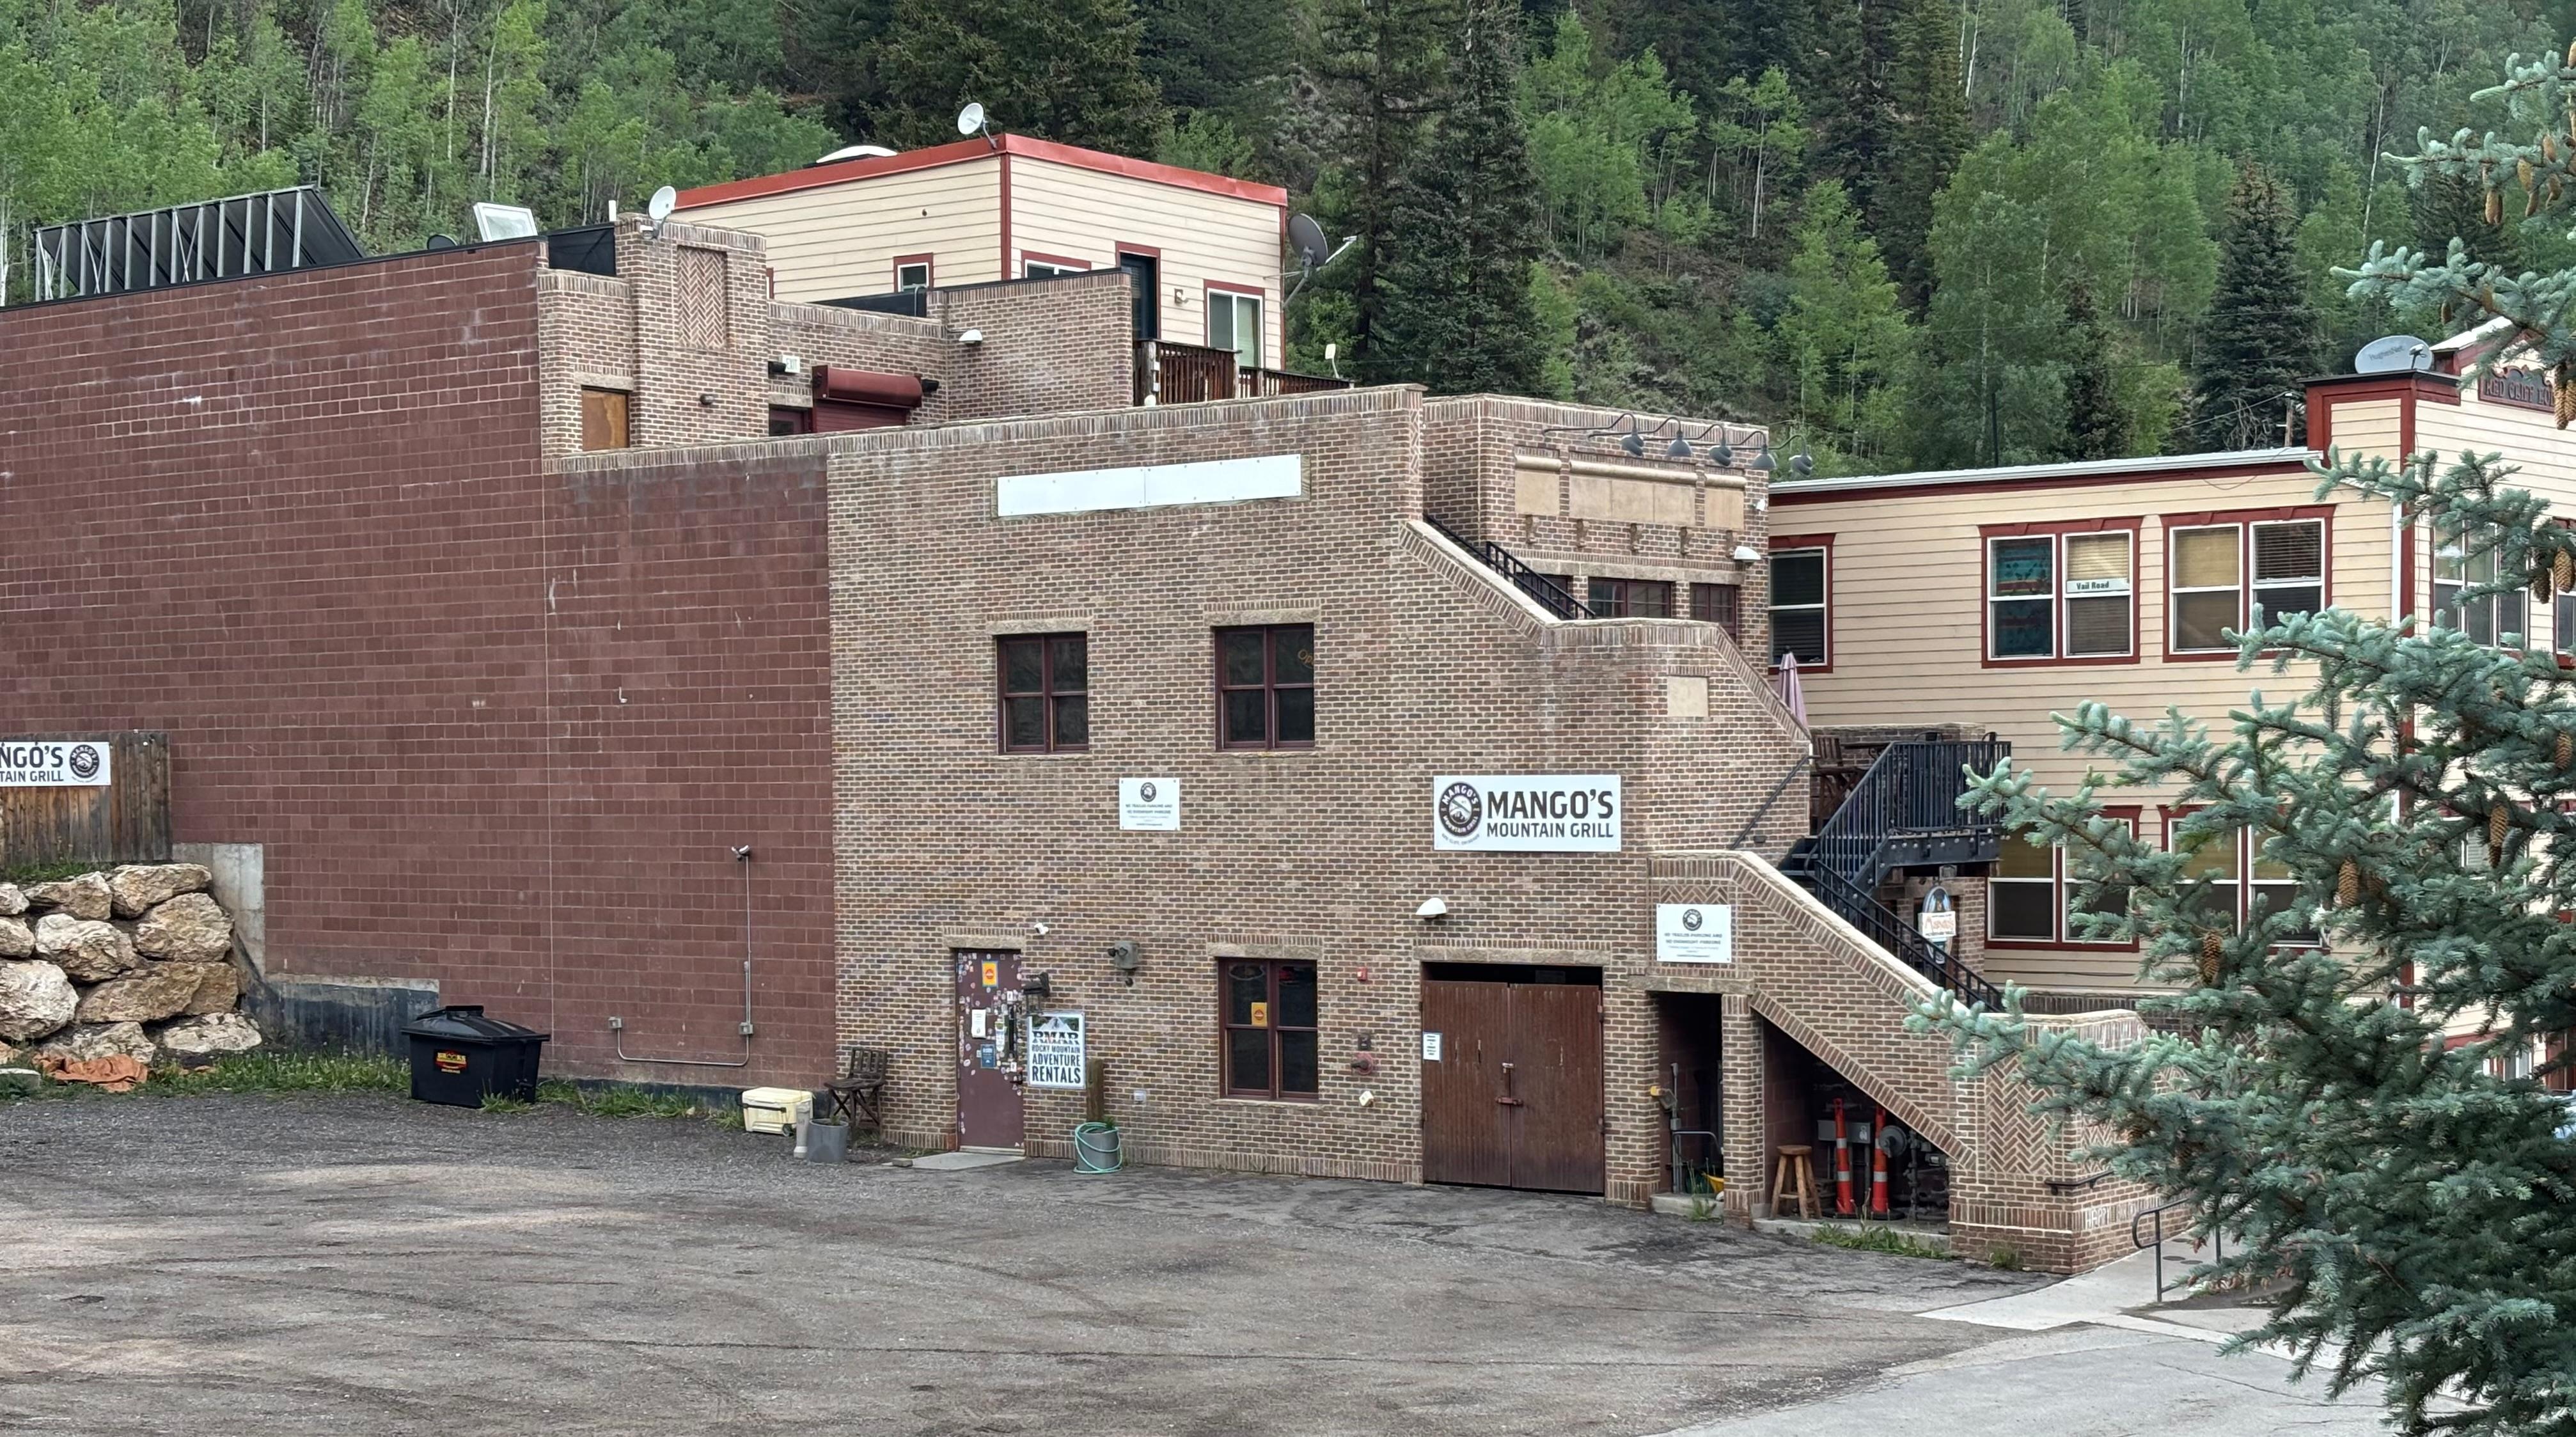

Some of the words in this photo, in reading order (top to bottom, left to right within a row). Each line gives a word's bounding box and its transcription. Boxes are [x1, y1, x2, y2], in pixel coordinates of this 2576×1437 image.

[2485, 379, 2505, 398] RED
[2508, 382, 2534, 403] CLIFF
[2092, 581, 2109, 589] Road
[30, 770, 64, 782] GRILL
[1441, 785, 1479, 805] MANGO'S
[1487, 789, 1614, 819] MANGO'S
[1487, 822, 1565, 838] MOUNTAIN
[1570, 822, 1614, 838] GRILL
[1032, 1030, 1080, 1045] RMAR
[1032, 1044, 1049, 1053] ROCKY
[1051, 1045, 1080, 1054] MOUNTAIN
[1032, 1053, 1081, 1067] ADVENTURE
[1032, 1065, 1081, 1084] RENTALS
